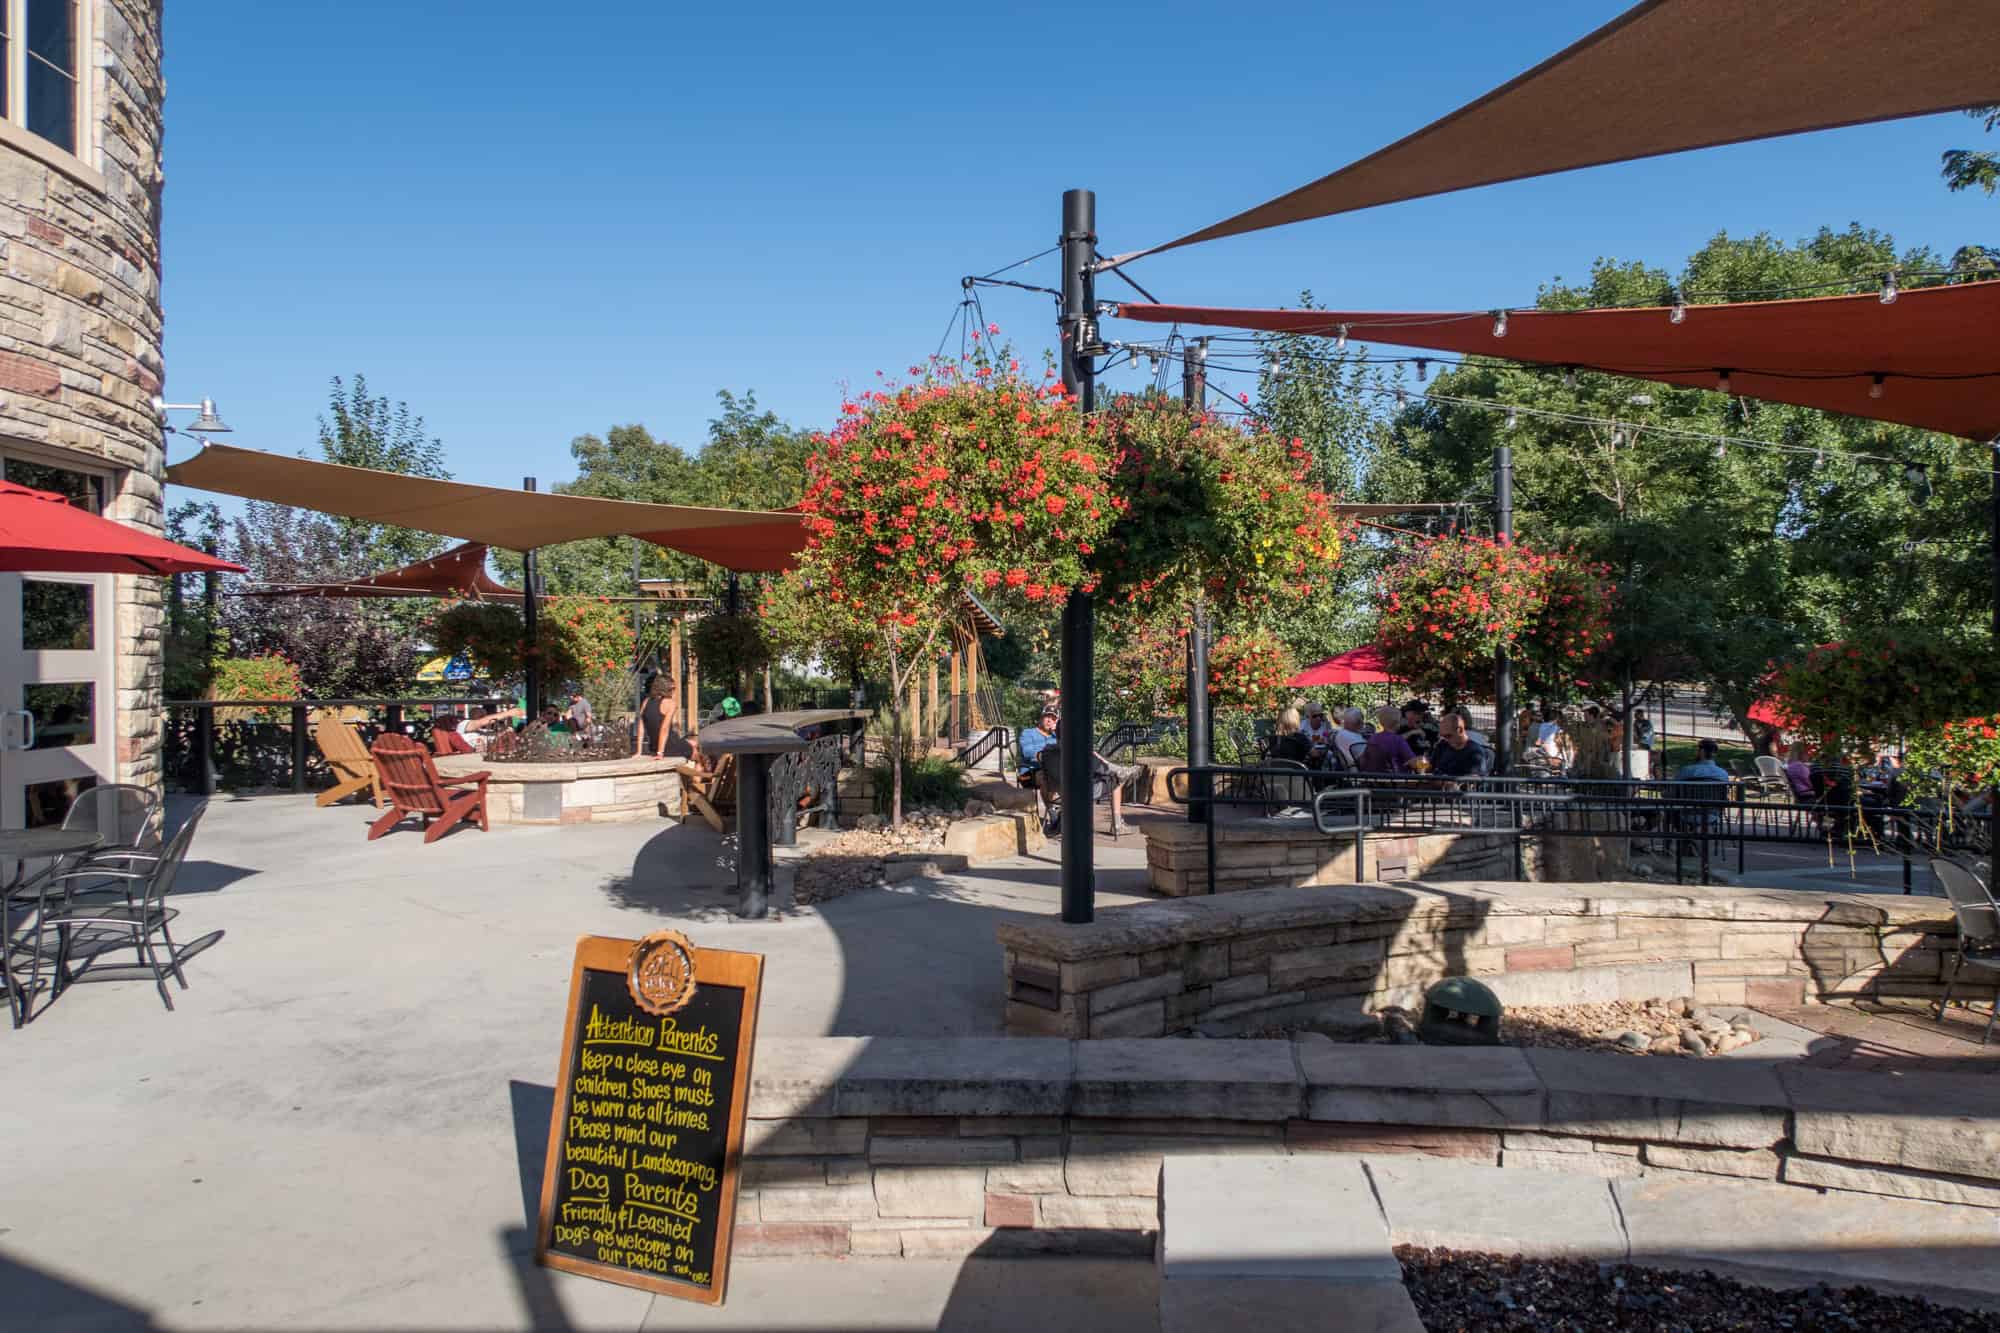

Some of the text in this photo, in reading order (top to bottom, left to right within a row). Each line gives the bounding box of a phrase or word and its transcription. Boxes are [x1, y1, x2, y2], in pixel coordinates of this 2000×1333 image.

[585, 1004, 718, 1054] Attention Parents
[581, 1048, 712, 1086] Keep a close eye on
[575, 1074, 715, 1107] children. Shoes must
[572, 1095, 710, 1131] be worn at all times.
[569, 1116, 678, 1150] Please mind our
[565, 1141, 719, 1192] beautiful Landscaping.
[568, 1167, 698, 1214] Dog Parents
[561, 1202, 617, 1233] Friendly
[628, 1208, 694, 1243] Leashed
[555, 1225, 694, 1263] Dogs are welcome on
[598, 1247, 623, 1265] our
